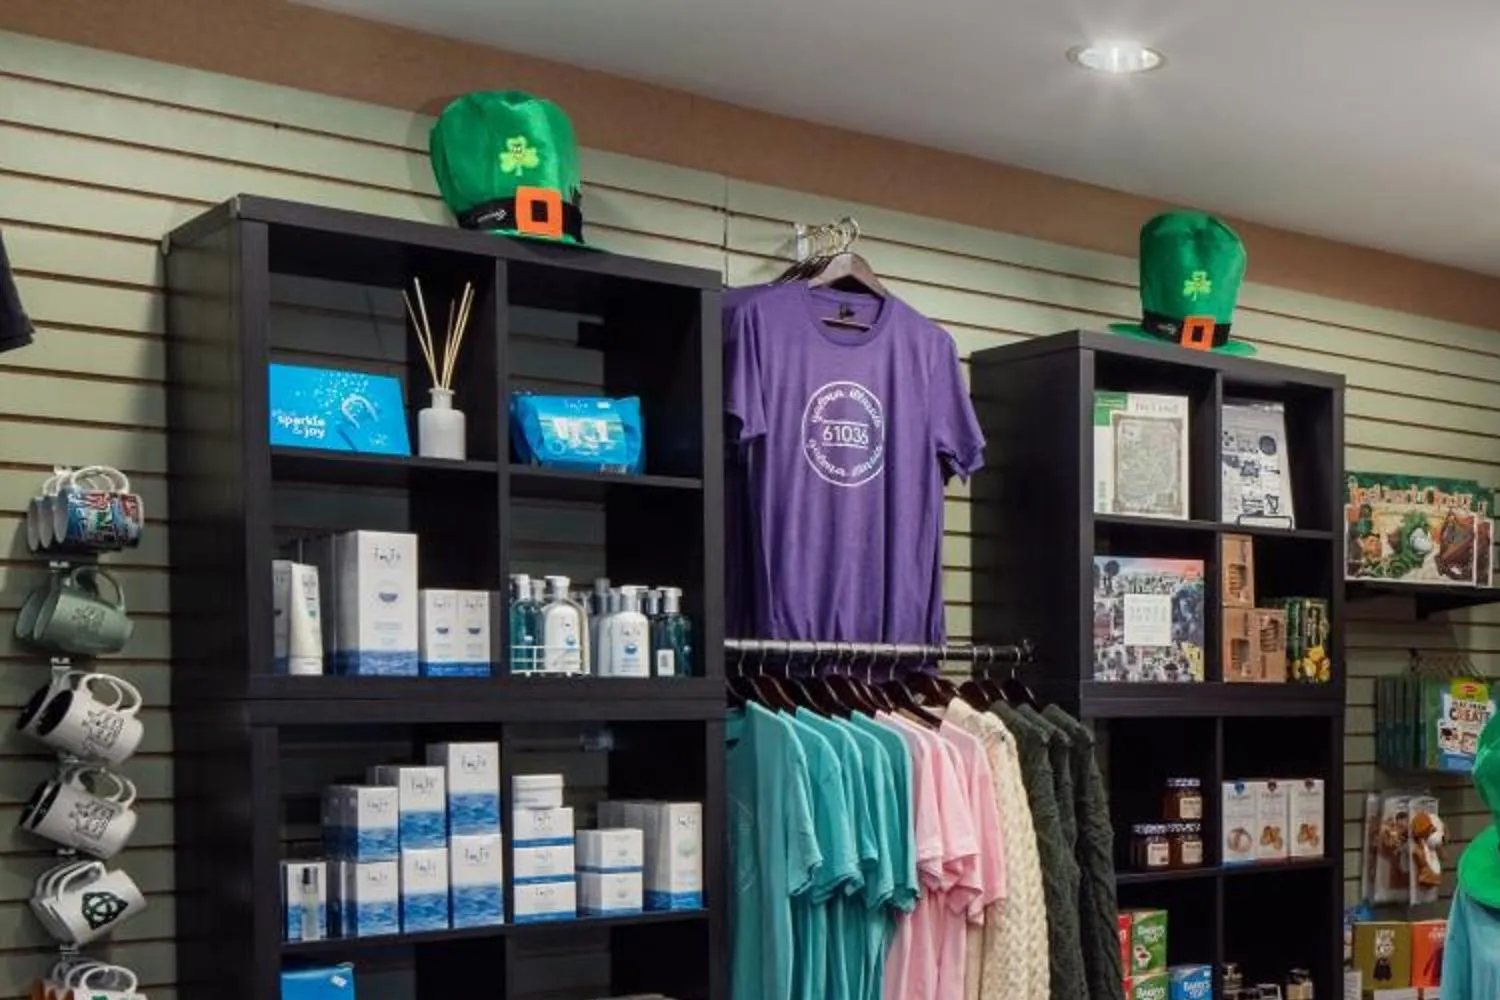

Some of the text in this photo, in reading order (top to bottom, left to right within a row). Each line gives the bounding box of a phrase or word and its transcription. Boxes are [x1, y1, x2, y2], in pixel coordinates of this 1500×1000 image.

[277, 415, 326, 428] sparkle
[304, 428, 326, 439] joy
[823, 426, 869, 445] 61036
[1449, 707, 1492, 722] CREAT
